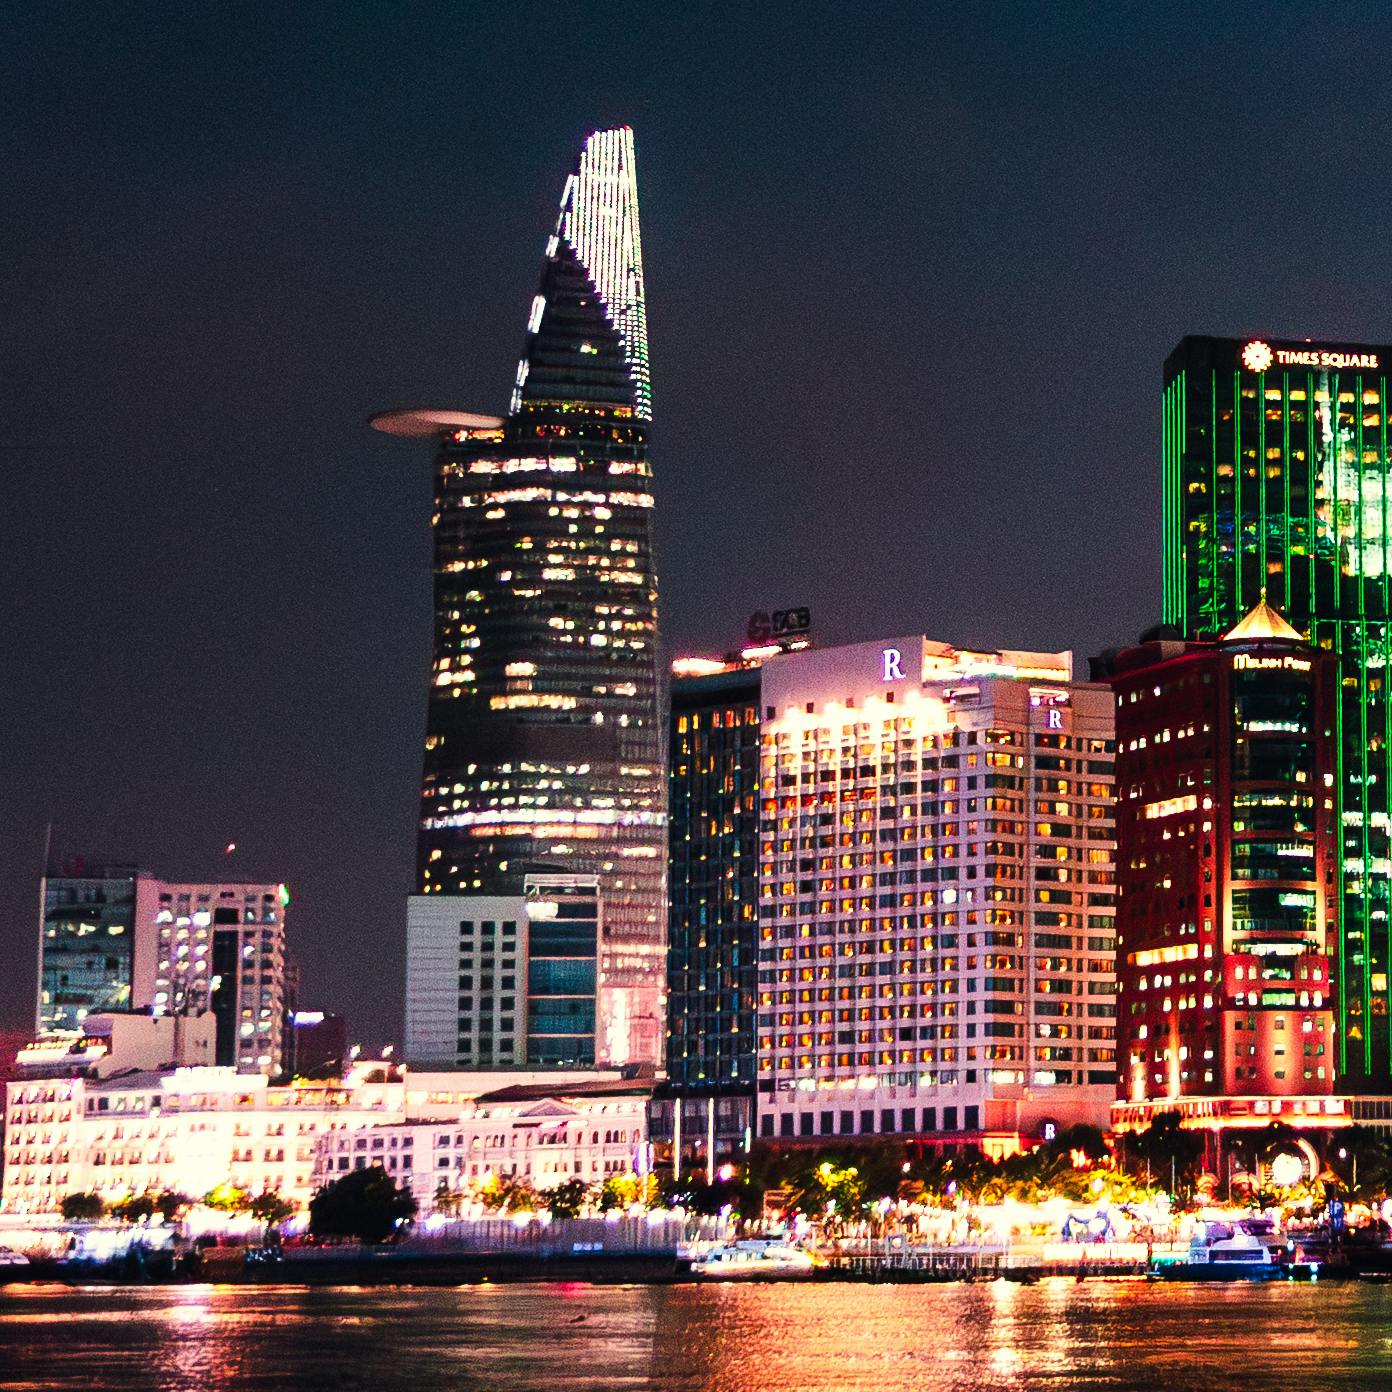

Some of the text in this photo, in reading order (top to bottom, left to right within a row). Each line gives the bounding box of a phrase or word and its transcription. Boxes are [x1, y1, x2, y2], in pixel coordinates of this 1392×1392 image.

[1276, 350, 1379, 369] TIMES SQUARE
[882, 648, 906, 681] R
[1049, 709, 1063, 728] R
[1045, 1123, 1056, 1140] R
